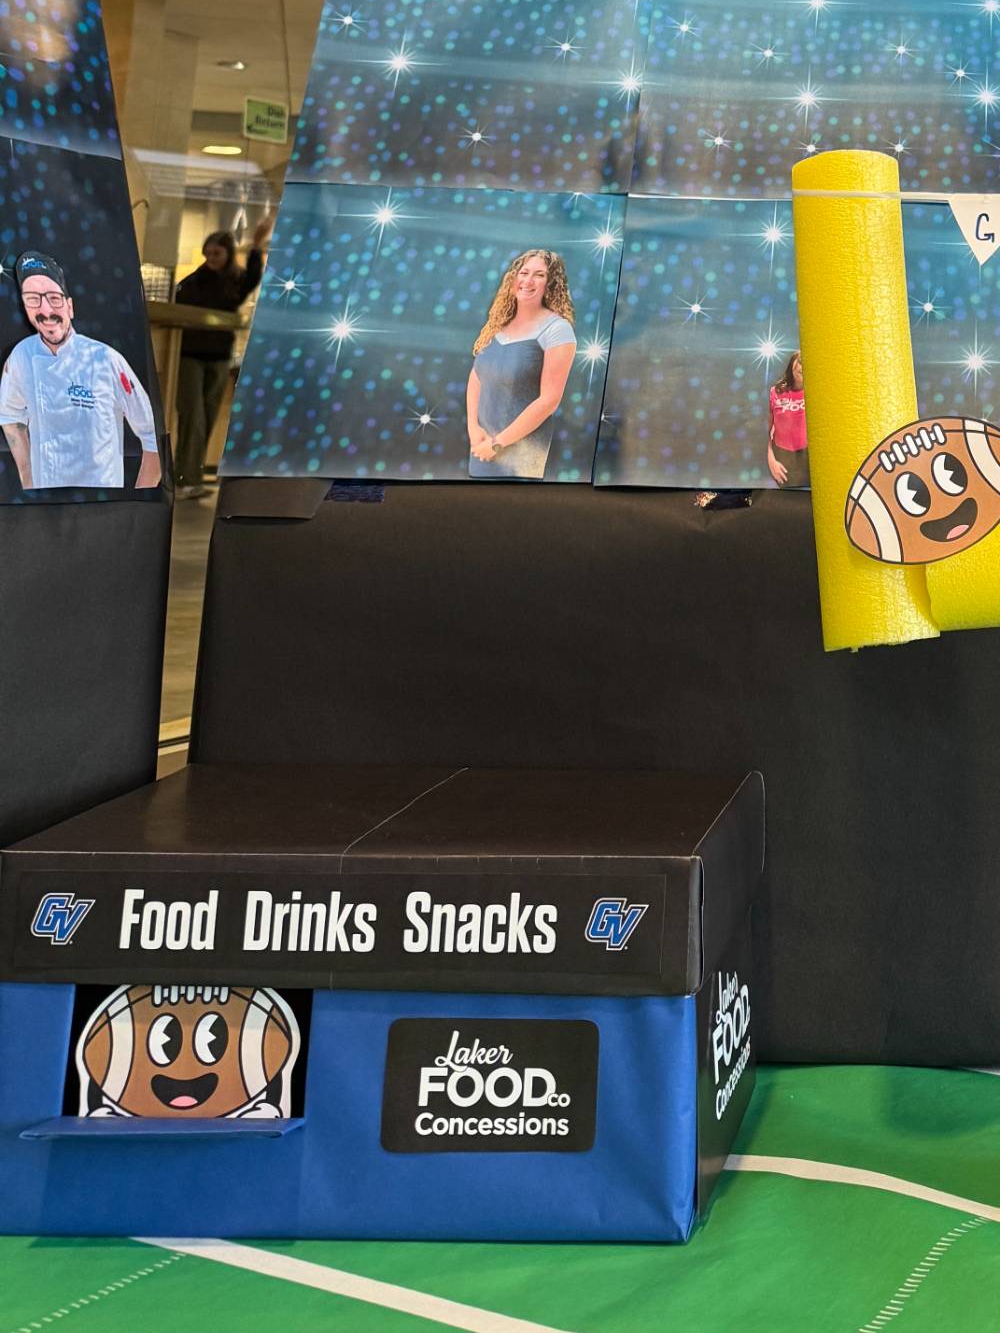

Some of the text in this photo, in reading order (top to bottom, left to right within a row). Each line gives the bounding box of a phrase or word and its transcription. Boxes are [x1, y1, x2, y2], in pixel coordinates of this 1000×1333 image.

[31, 888, 649, 954] GV Food Drinks Snacks GV
[434, 1030, 513, 1072] Laker
[712, 983, 749, 1086] FOOD
[418, 1067, 556, 1107] FOOD
[415, 1112, 569, 1136] Concessions
